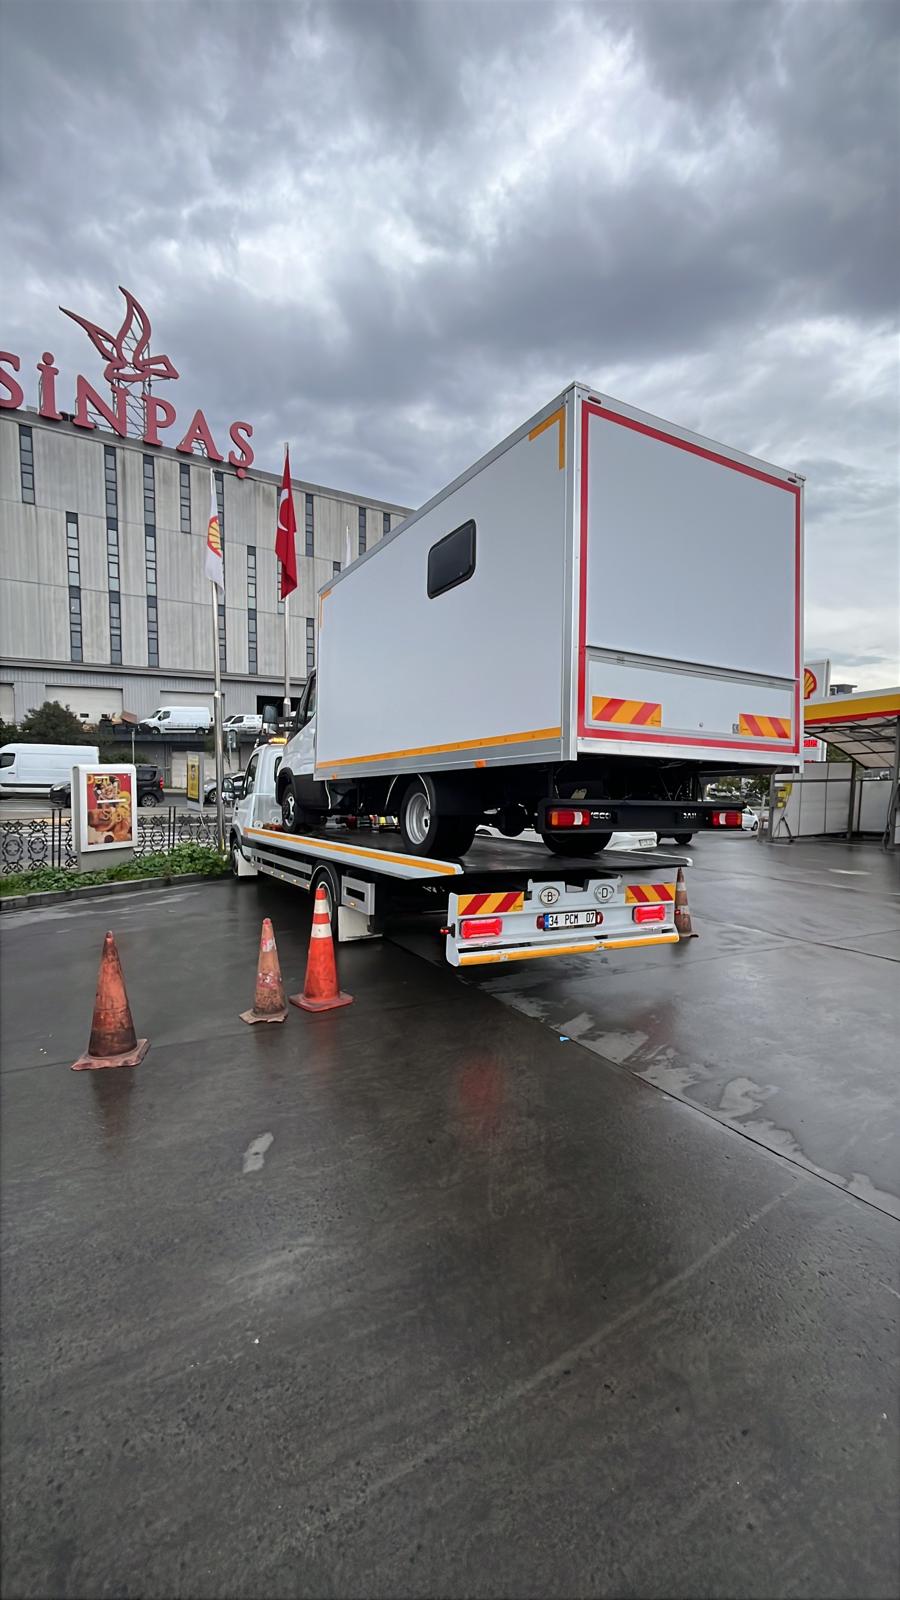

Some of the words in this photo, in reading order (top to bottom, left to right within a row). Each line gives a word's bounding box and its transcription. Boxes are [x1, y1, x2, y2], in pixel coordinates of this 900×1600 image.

[0, 350, 255, 479] SİNPAŞ
[547, 891, 553, 902] B
[601, 887, 609, 898] D
[549, 915, 559, 926] 34
[565, 913, 579, 925] PCM
[586, 912, 595, 923] 07
